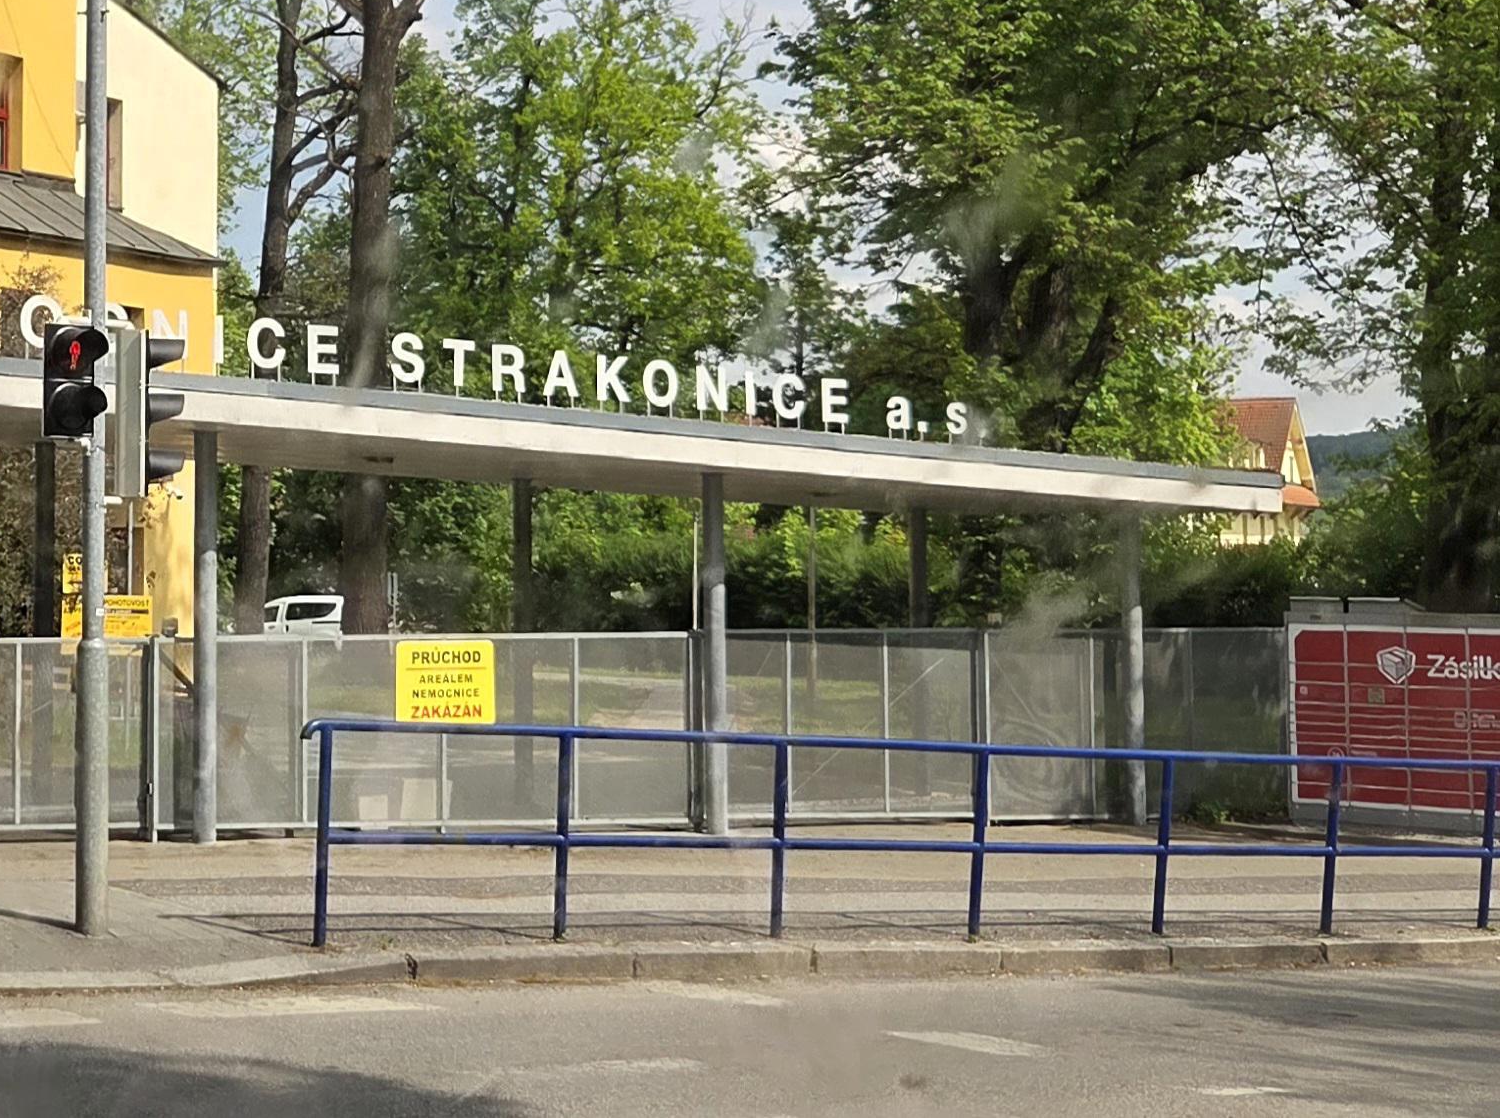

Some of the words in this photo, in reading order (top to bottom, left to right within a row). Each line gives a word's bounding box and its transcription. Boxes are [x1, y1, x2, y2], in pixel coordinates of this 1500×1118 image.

[390, 331, 850, 424] STRAKONICE
[411, 646, 482, 664] PRŮCHOD
[419, 671, 474, 684] AREÁLEM
[412, 688, 480, 699] NEMOCNICE
[411, 701, 483, 720] ZAKÁZÁN
